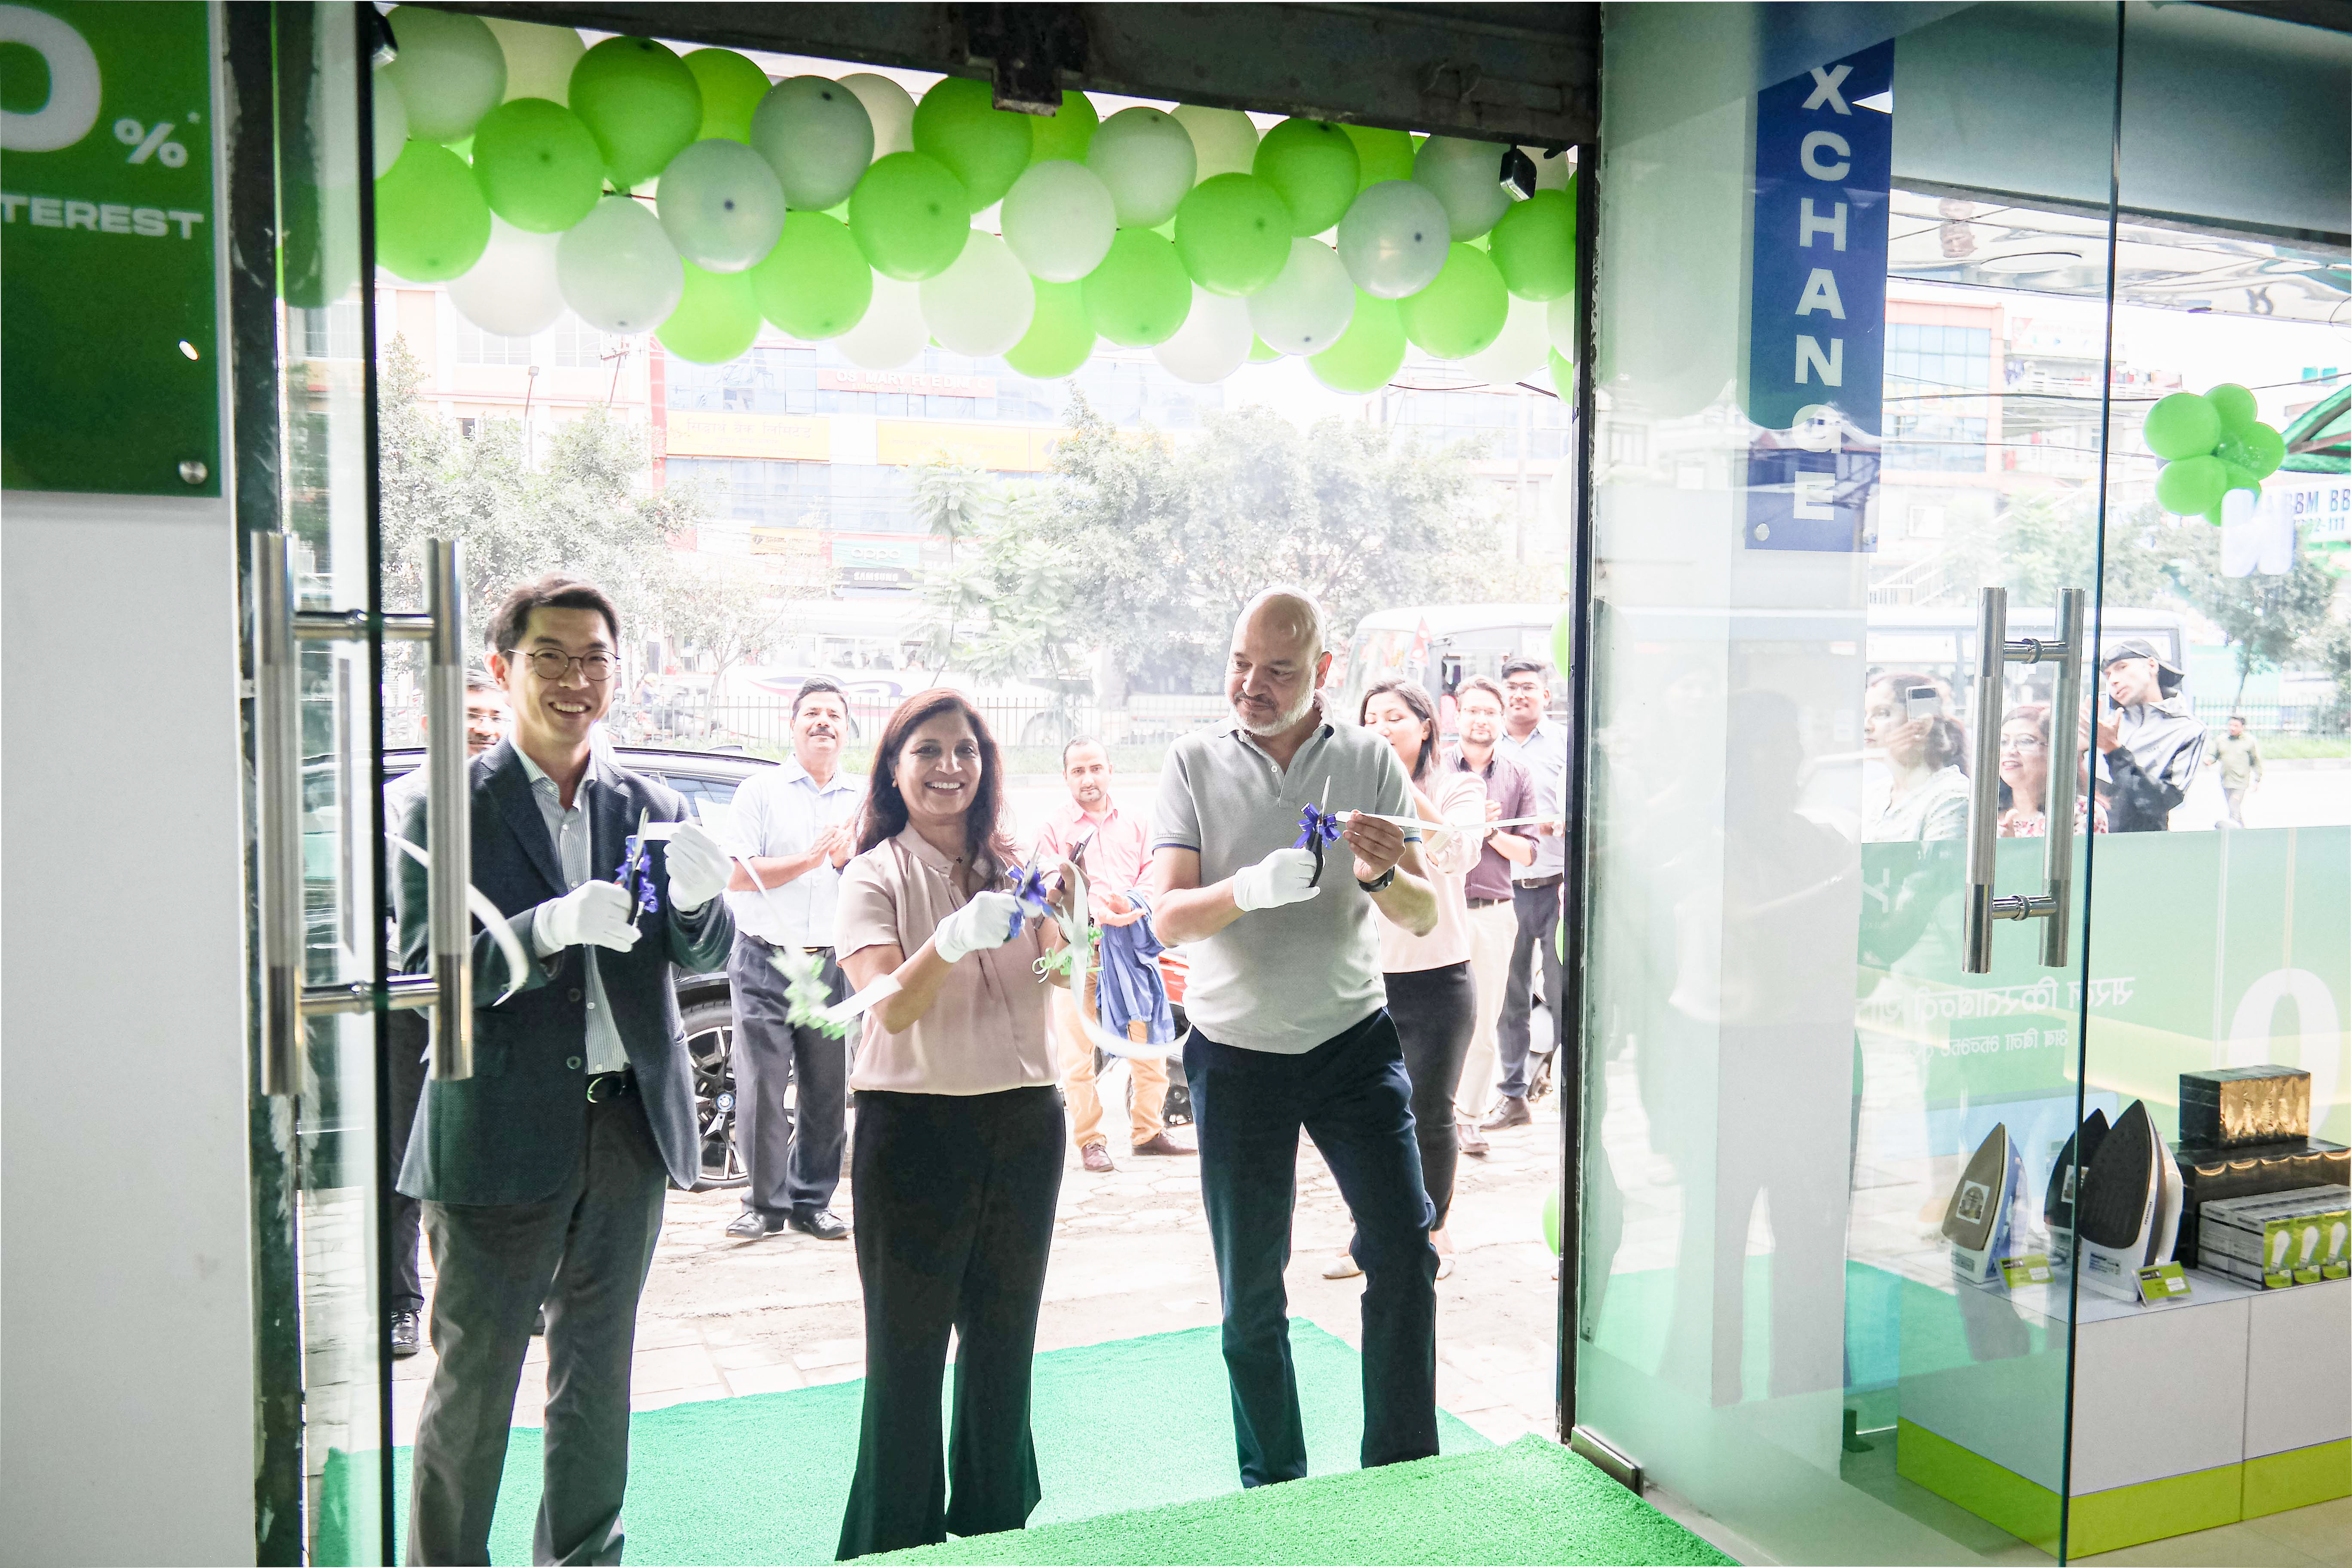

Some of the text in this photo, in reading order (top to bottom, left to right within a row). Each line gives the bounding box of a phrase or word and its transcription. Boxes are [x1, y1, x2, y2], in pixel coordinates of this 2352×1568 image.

[0, 193, 205, 240] TEREST
[1792, 64, 1853, 520] XCHANGE
[851, 548, 901, 561] oppo
[853, 572, 899, 582] SAMSUNG
